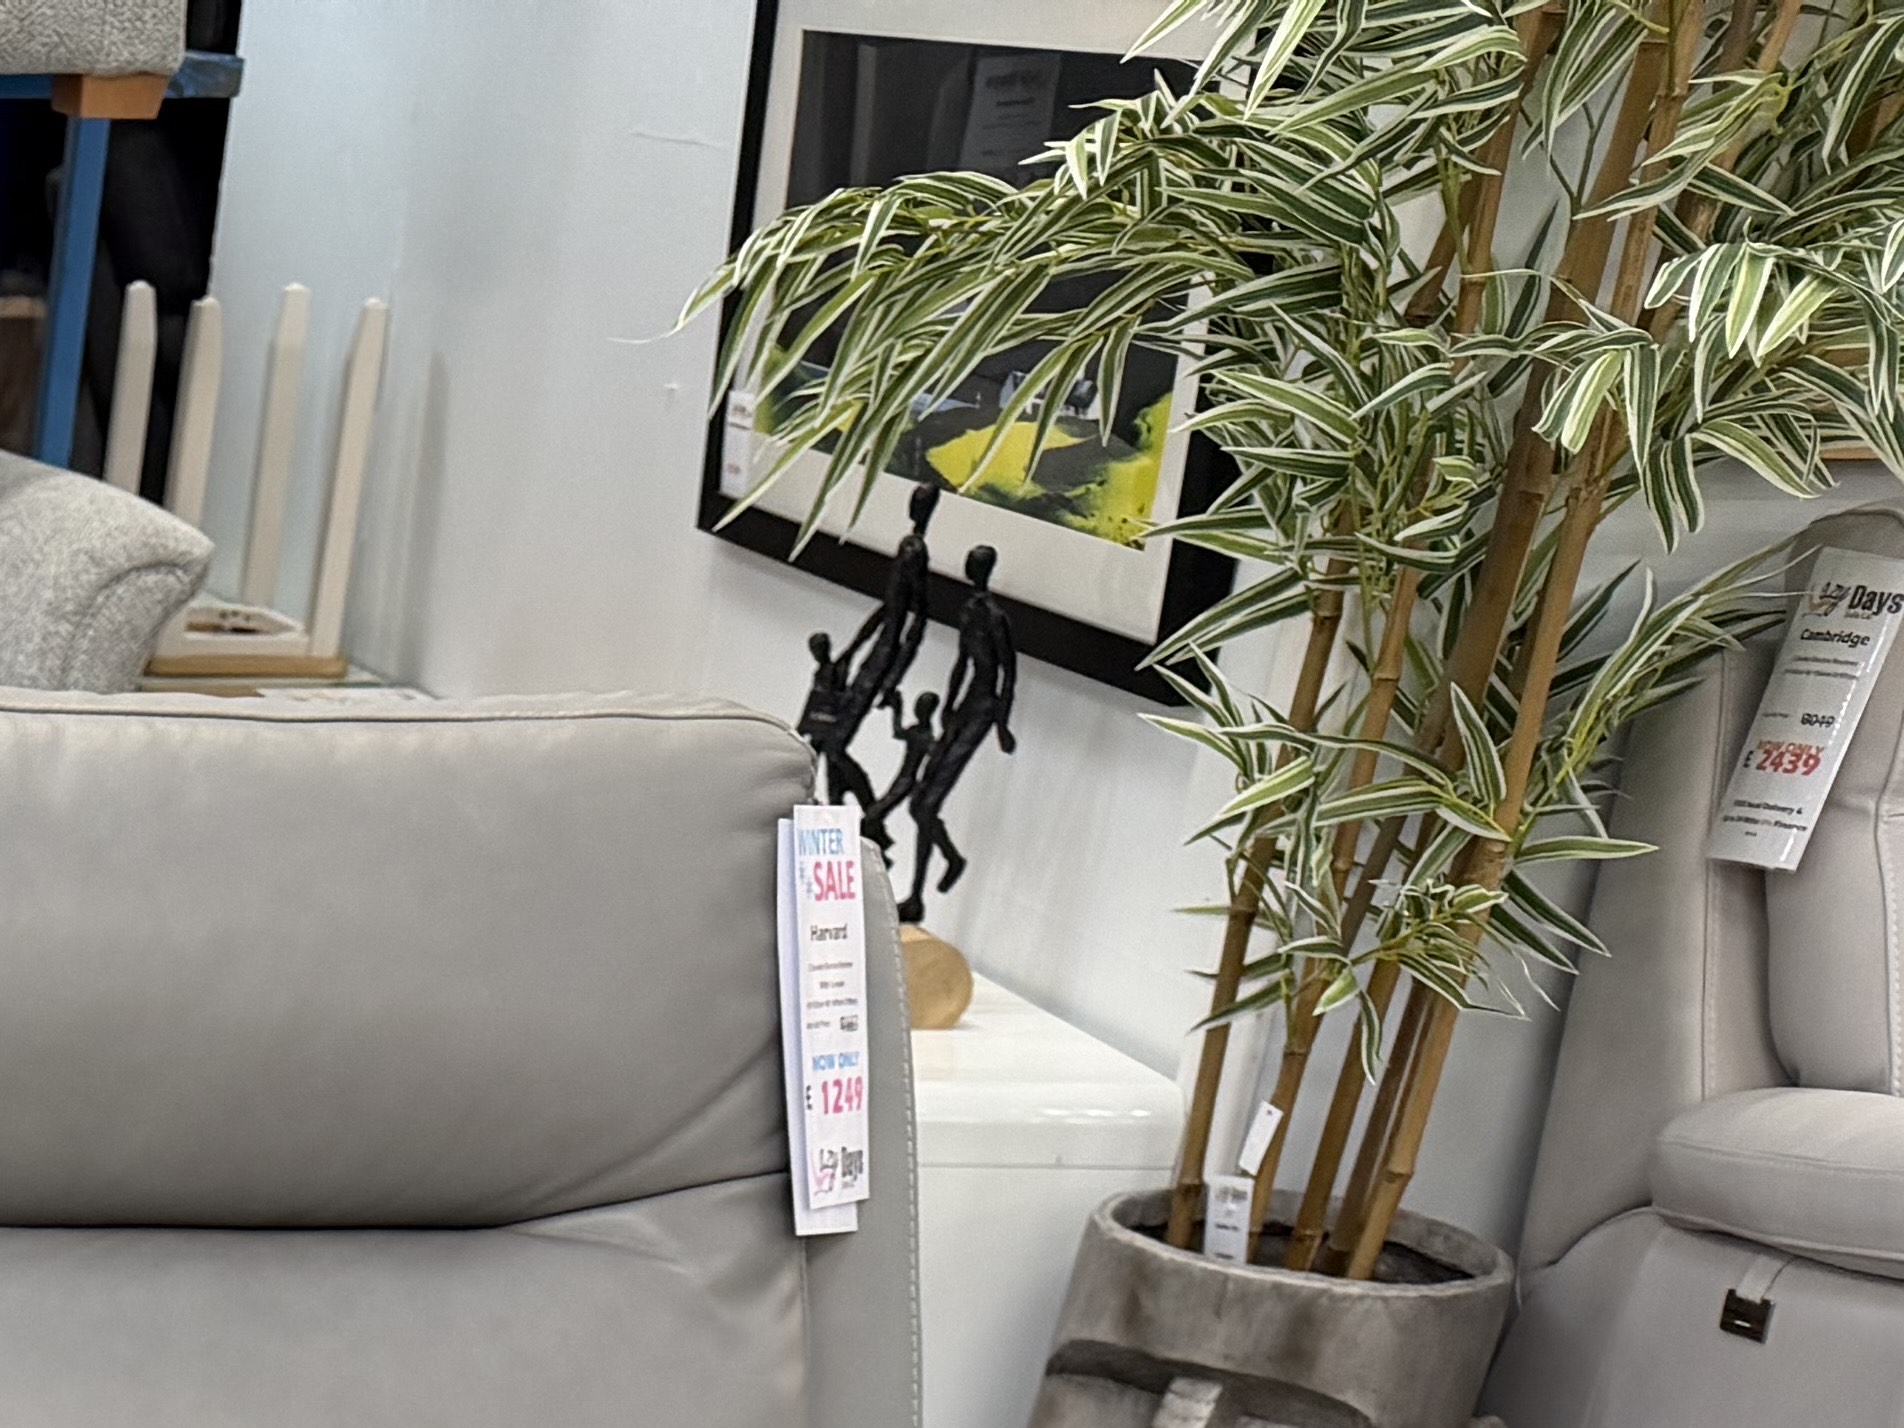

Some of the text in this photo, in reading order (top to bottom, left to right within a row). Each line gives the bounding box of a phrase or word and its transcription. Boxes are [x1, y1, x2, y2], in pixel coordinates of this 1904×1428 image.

[1848, 585, 1904, 616] Days
[1756, 749, 1822, 776] 2439
[813, 860, 856, 902] SALE
[821, 1075, 864, 1115] 1249
